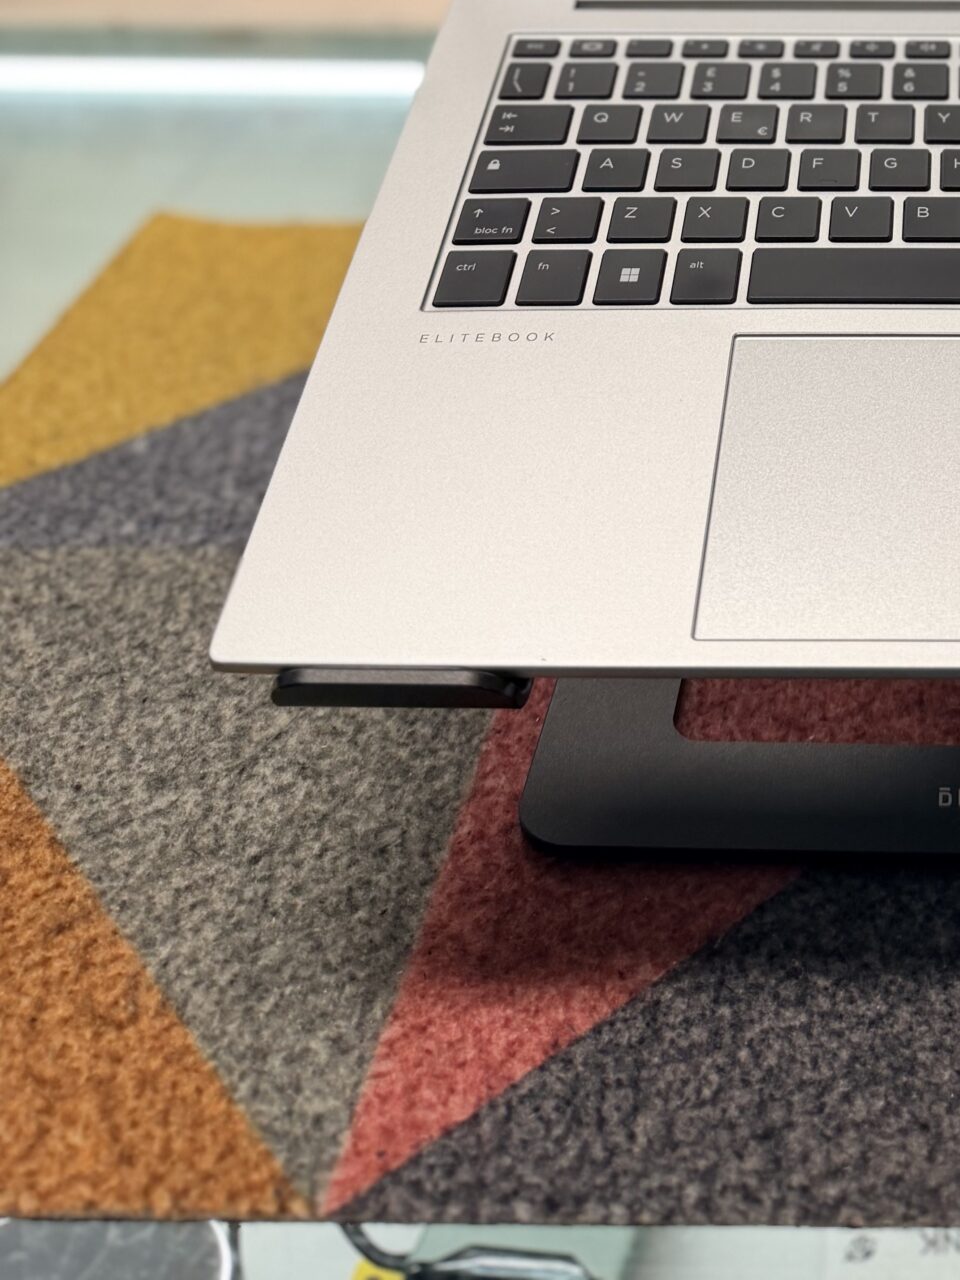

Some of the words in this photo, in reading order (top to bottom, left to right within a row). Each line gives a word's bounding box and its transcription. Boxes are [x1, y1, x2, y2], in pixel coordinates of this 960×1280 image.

[634, 81, 646, 93] 2
[702, 81, 713, 93] 3
[769, 81, 781, 92] 4
[837, 81, 848, 93] 5
[902, 81, 915, 93] 6
[593, 111, 609, 124] Q
[663, 111, 684, 123] W
[730, 111, 743, 123] E
[799, 111, 813, 123] R
[867, 111, 879, 123] T
[937, 112, 951, 124] Y
[757, 126, 768, 136] €
[599, 157, 614, 169] A
[670, 157, 683, 169] S
[741, 157, 756, 169] D
[812, 157, 824, 169] F
[883, 157, 898, 169] G
[624, 206, 639, 219] Z
[697, 206, 712, 218] X
[771, 206, 785, 218] C
[844, 206, 859, 218] V
[917, 206, 930, 218] B
[474, 226, 498, 235] bloc
[501, 226, 513, 234] fn
[455, 262, 477, 272] ctrl
[537, 261, 550, 271] fn
[689, 260, 705, 269] alt
[419, 332, 556, 344] ELITEBOOK
